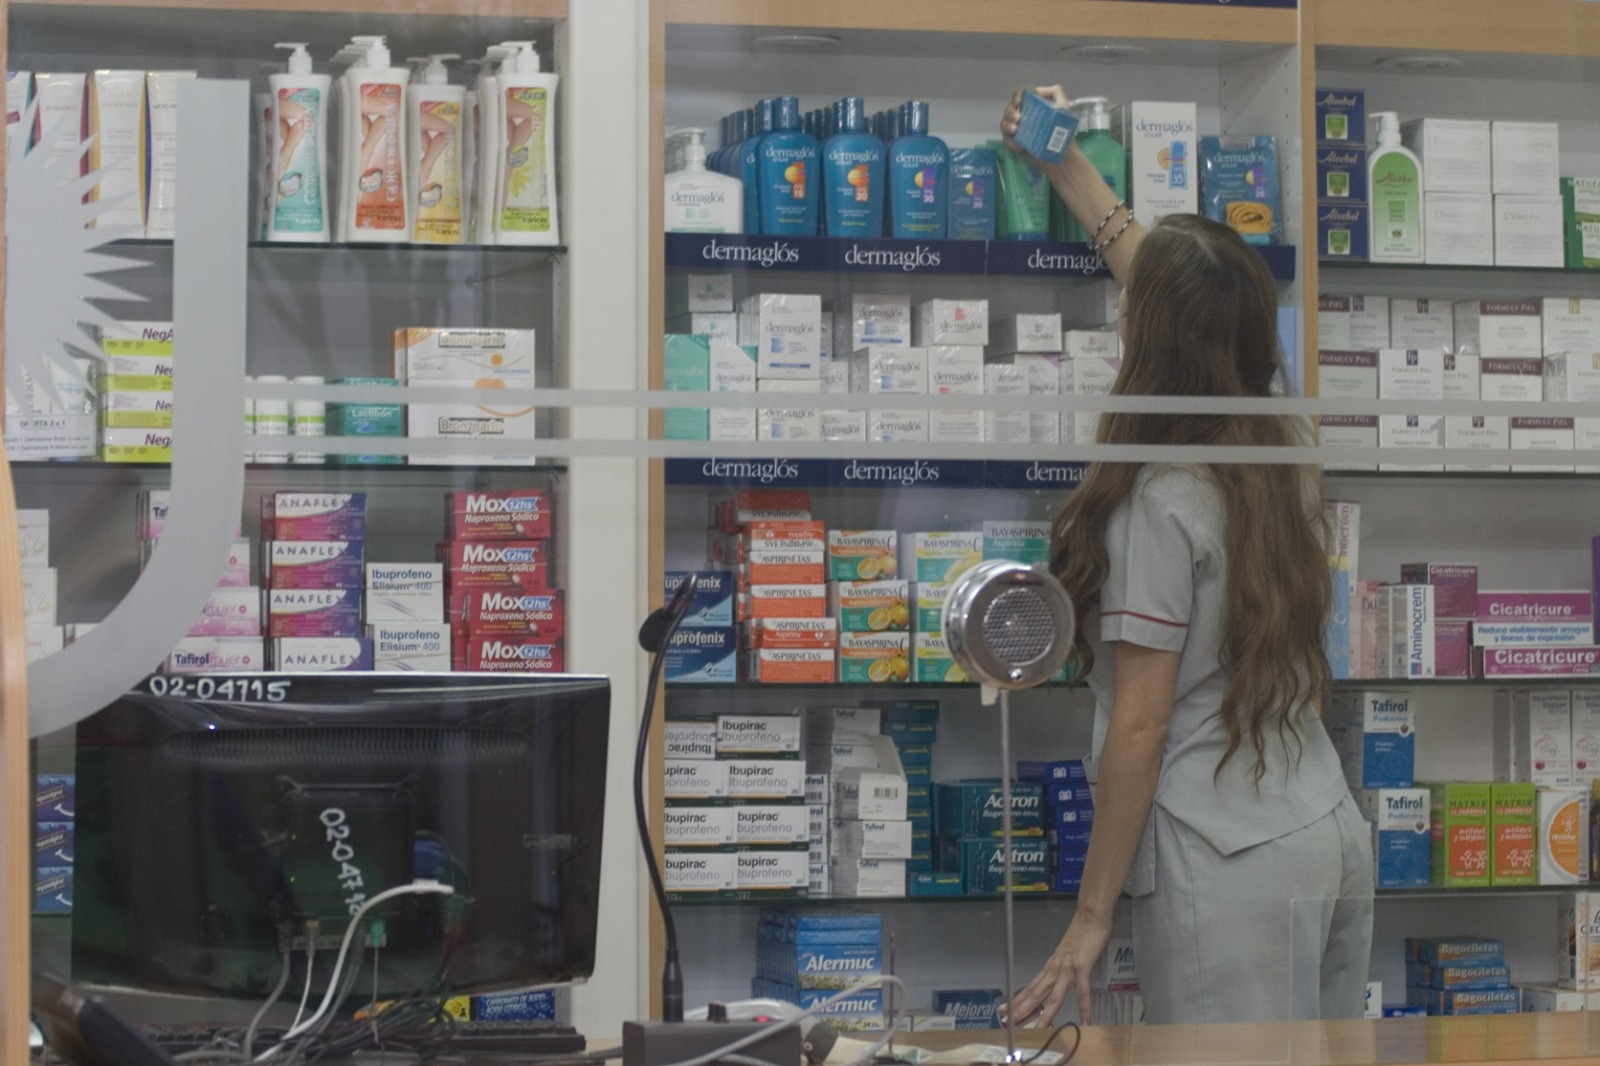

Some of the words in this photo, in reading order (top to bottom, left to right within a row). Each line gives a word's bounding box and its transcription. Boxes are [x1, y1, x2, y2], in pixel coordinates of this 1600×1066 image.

[1136, 120, 1193, 134] dermaglós
[765, 146, 816, 160] dermaglós
[1171, 173, 1183, 184] 35
[856, 192, 868, 202] 20
[923, 193, 934, 203] 30
[702, 239, 799, 267] dermaglós
[844, 244, 940, 271] dermaglós
[1028, 246, 1105, 273] dermagl
[1486, 303, 1520, 312] FORMULY
[765, 322, 814, 335] dermaglós
[1319, 354, 1353, 363] FORMULY
[351, 408, 392, 418] Lactibón
[702, 457, 799, 483] dermaglós
[844, 459, 940, 485] dermaglós
[278, 497, 350, 509] ANAFLEX
[466, 495, 509, 513] Mox
[509, 499, 533, 510] 12hs
[464, 514, 510, 524] Naproxeno
[510, 513, 539, 522] Sódico
[837, 536, 886, 546] BAYASPIRINA
[886, 535, 894, 551] C
[923, 539, 973, 549] BAYASPIRINA
[973, 536, 981, 552] C
[275, 546, 347, 555] ANAFLEX
[463, 544, 506, 562] Mox
[505, 549, 531, 560] 12hs
[762, 555, 811, 564] ASPIRINETAS
[461, 563, 507, 573] Naproxeno
[507, 562, 536, 572] Sódico
[1430, 566, 1476, 575] Cicatricure
[372, 569, 432, 582] Ibuprofeno
[273, 594, 345, 604] ANAFLEX
[763, 588, 812, 598] ASPIRINETAS
[847, 586, 898, 596] BAYASPIRINA
[898, 585, 906, 601] C
[481, 592, 523, 611] Mox
[522, 598, 548, 608] 12hs
[1489, 602, 1572, 616] Cicatricure
[480, 612, 524, 622] Naproxeno
[524, 611, 553, 621] Sódico
[776, 621, 825, 631] ASPIRINETAS
[1410, 587, 1422, 661] Aminocrem
[380, 630, 440, 643] Ibuprofeno
[1509, 626, 1558, 634] visiblemente
[1560, 627, 1590, 635] arrugas
[669, 631, 725, 647] uprofenix
[1537, 634, 1575, 643] expresión
[380, 642, 418, 652] Elisium
[422, 642, 440, 652] 400
[481, 641, 523, 660] Mox
[522, 646, 547, 657] 12hs
[848, 638, 899, 648] BAYASPIRINA
[900, 637, 907, 653] C
[174, 653, 209, 665] Tafirol
[284, 655, 360, 665] ANAFLEX
[771, 652, 821, 662] ASPIRINETAS
[1494, 649, 1595, 665] Cicatricure
[480, 660, 524, 670] Naproxeno
[524, 659, 552, 669] Sódico
[1371, 700, 1408, 713] Tafirol
[722, 720, 767, 732] Ibupirac
[722, 731, 781, 743] Ibuprofeno
[668, 743, 712, 754] Ibupirac
[730, 765, 774, 777] Ibupirac
[729, 777, 788, 789] Ibuprofeno
[1386, 796, 1423, 809] Tafirol
[737, 811, 779, 823] bupirac
[810, 807, 824, 815] irol
[665, 813, 706, 825] bupirac
[665, 824, 720, 836] buprofeno
[737, 823, 792, 835] buprofeno
[864, 823, 885, 831] Tafirol
[665, 859, 706, 871] bupirac
[737, 856, 778, 868] bupirac
[737, 868, 792, 880] buprofeno
[809, 866, 824, 874] irol
[665, 871, 720, 882] buprofeno
[1442, 944, 1500, 955] Bagociletas
[805, 954, 875, 971] Alermuc
[1448, 967, 1506, 978] Bagociletas
[1456, 992, 1516, 1005] Bagociletas
